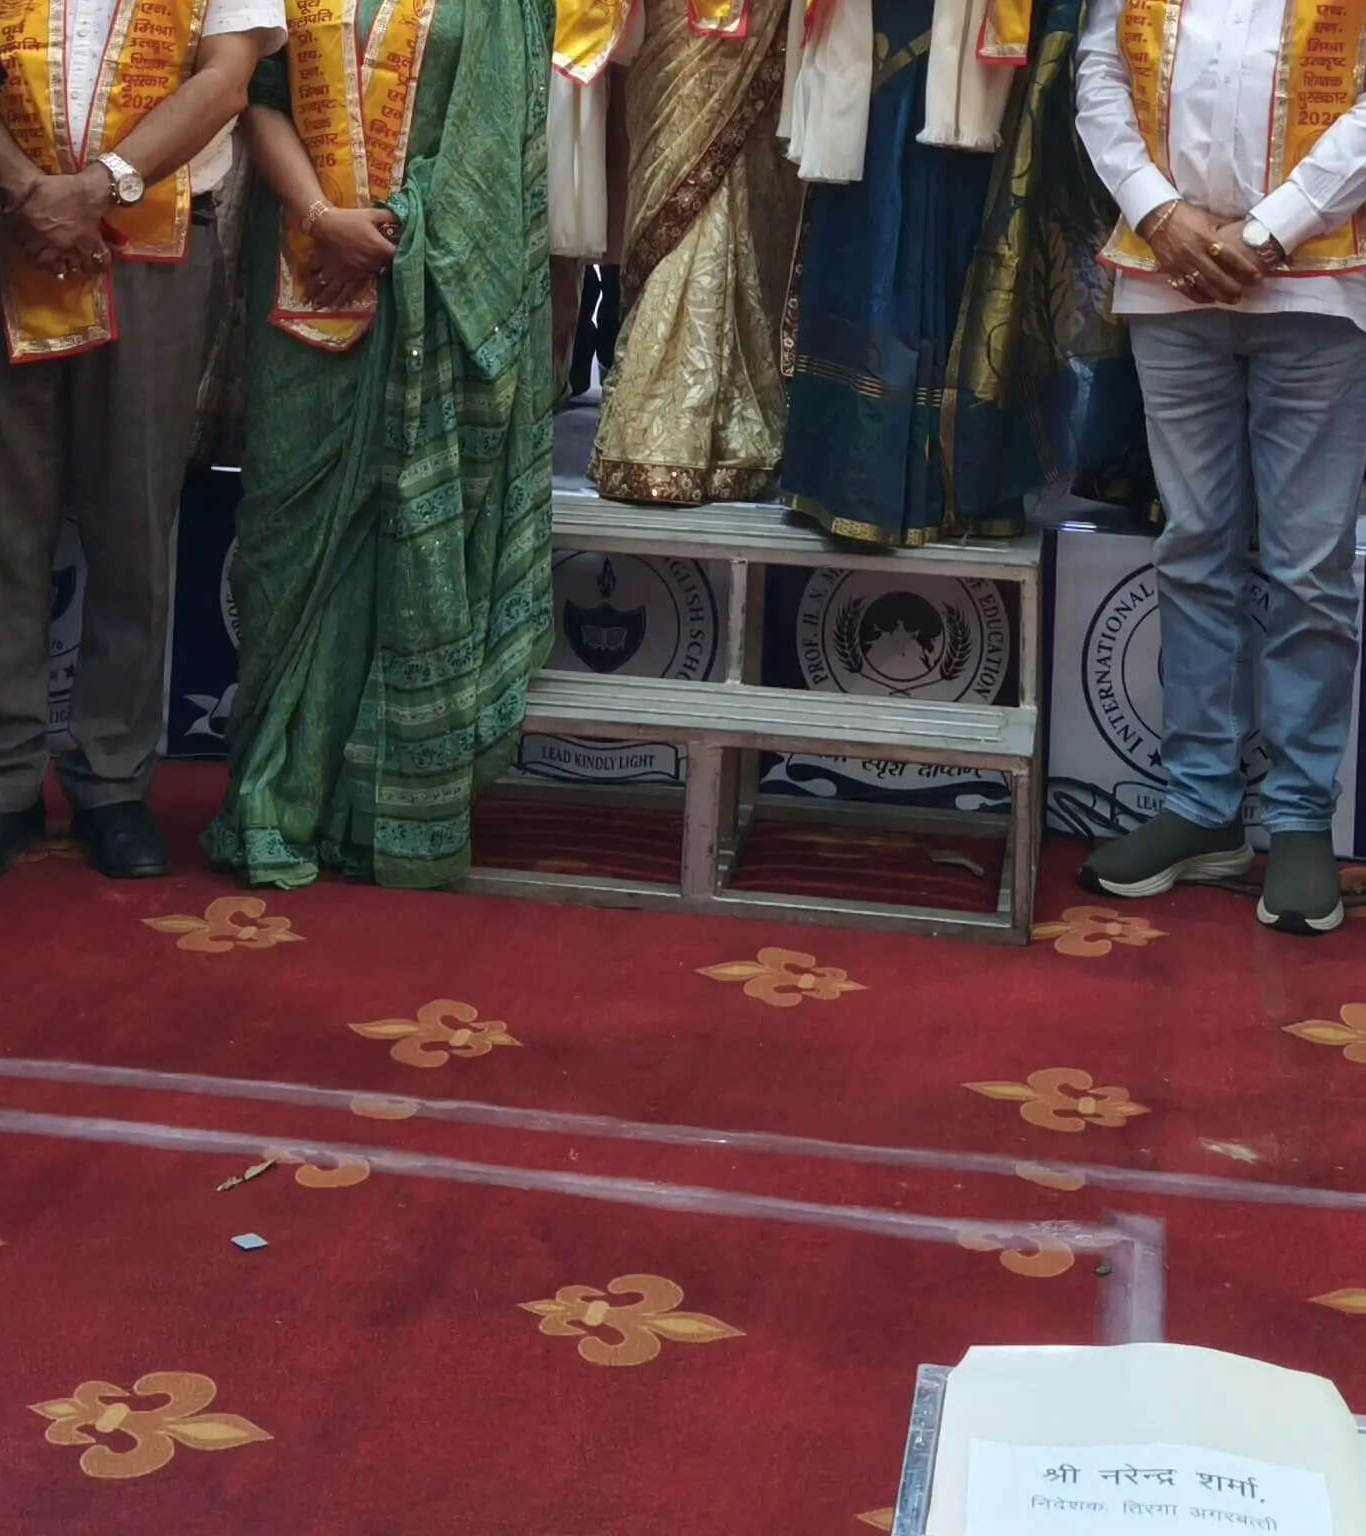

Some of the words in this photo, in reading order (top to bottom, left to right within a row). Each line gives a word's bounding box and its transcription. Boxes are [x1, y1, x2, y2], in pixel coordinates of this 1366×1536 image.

[974, 593, 1004, 700] EDUCATION
[1095, 582, 1155, 754] INTERNATIONAL
[542, 746, 571, 763] LEAD
[574, 753, 617, 770] KINDLY
[619, 754, 656, 770] LIGHT
[1043, 1464, 1080, 1484] श्री
[1098, 1463, 1177, 1487] नरेन्द्र
